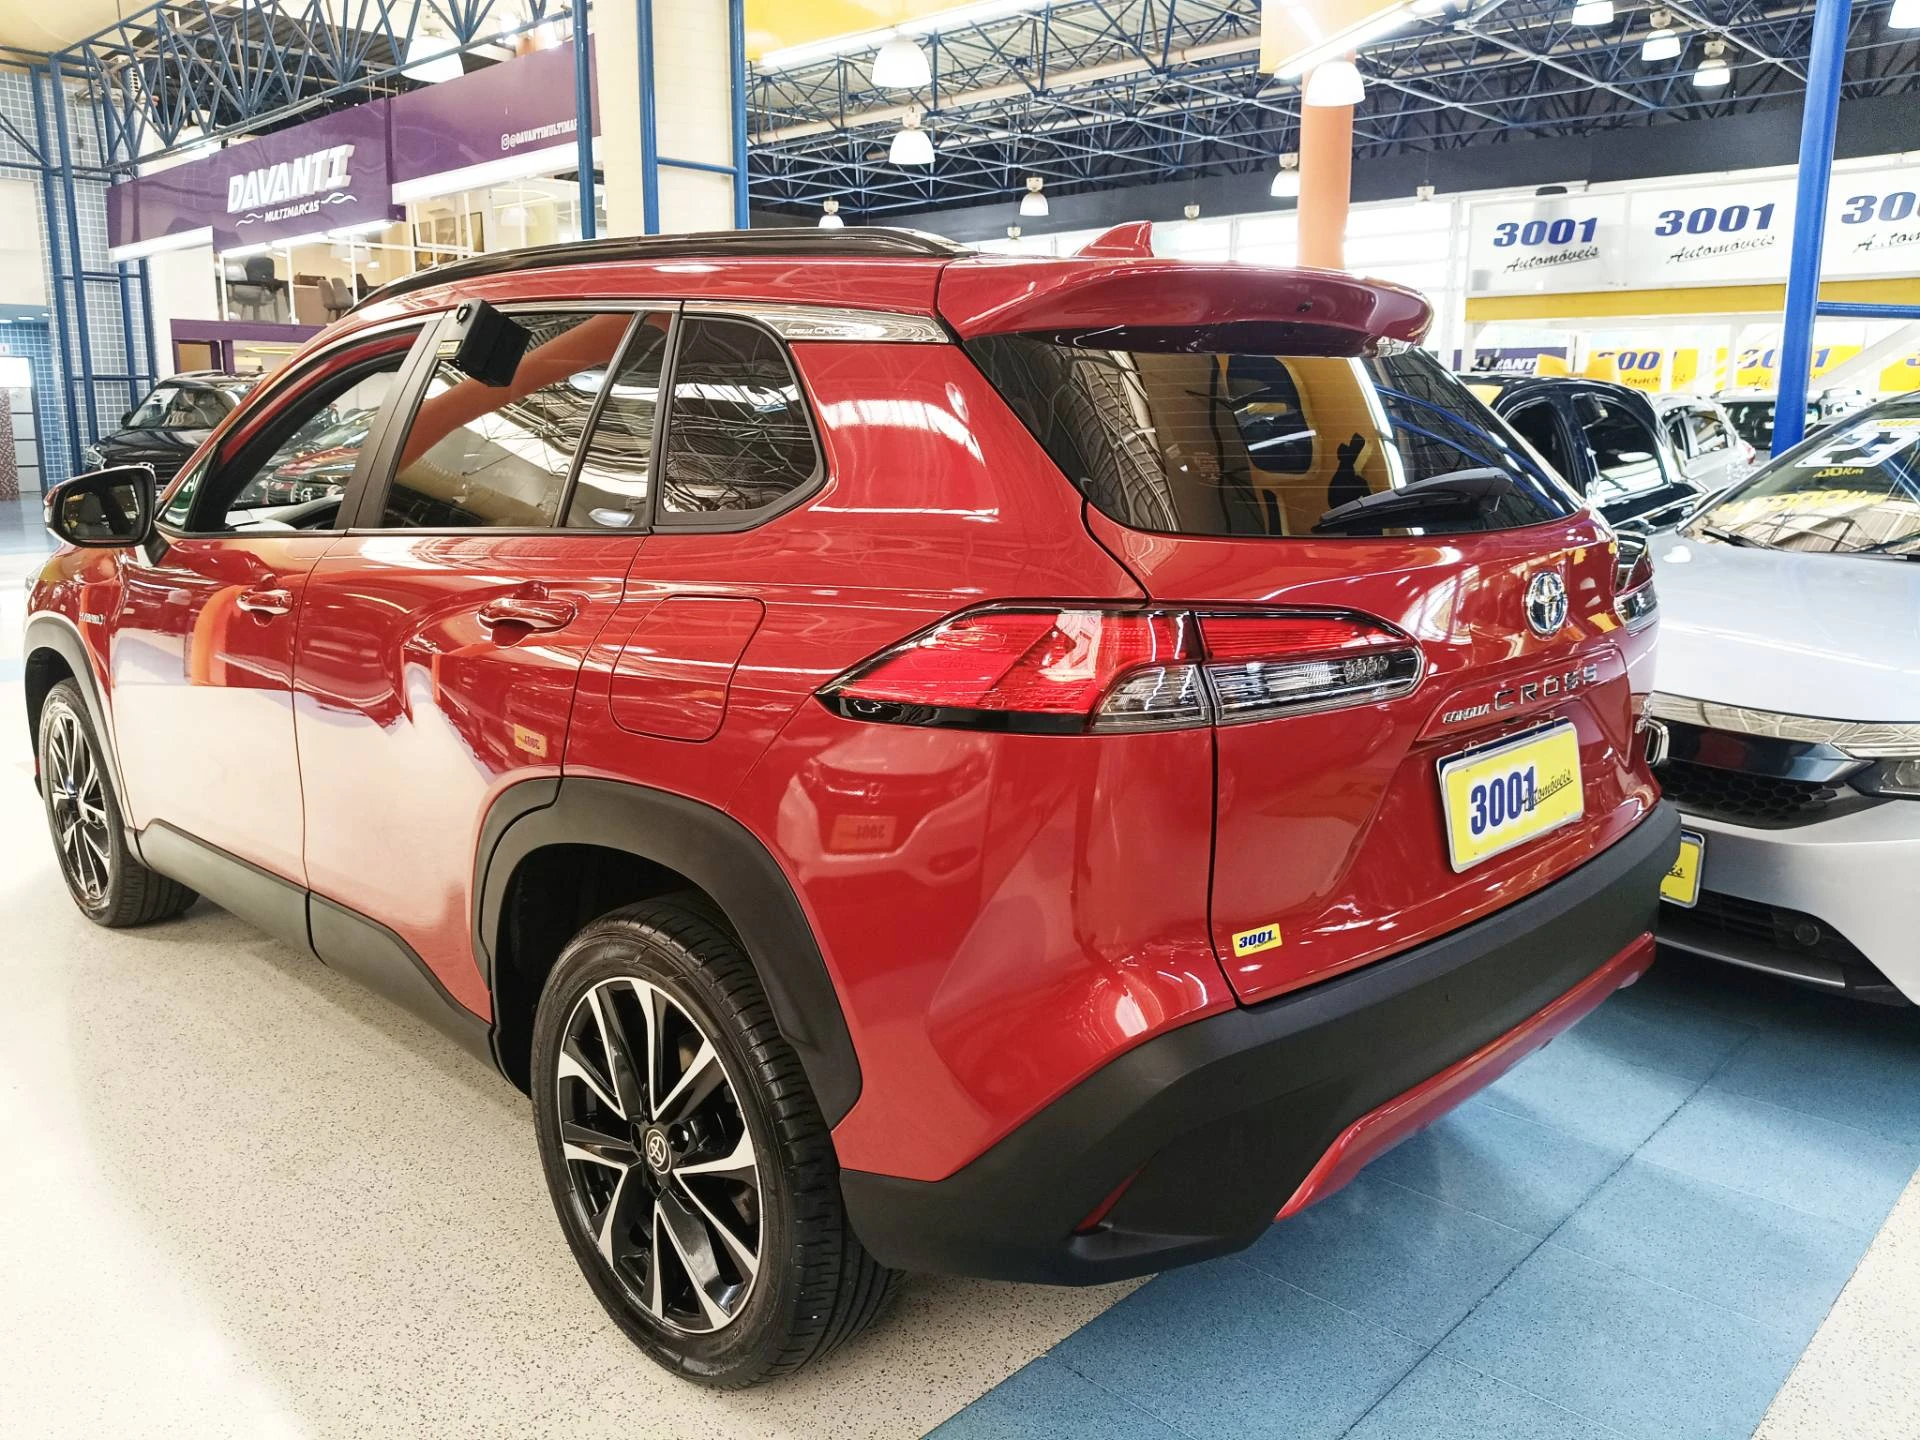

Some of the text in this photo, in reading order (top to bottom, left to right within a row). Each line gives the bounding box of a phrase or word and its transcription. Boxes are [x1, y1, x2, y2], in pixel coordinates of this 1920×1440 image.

[227, 144, 355, 214] DAVANTI
[264, 200, 319, 222] MULTIMARCAS
[1654, 203, 1775, 236] 3001
[1841, 191, 1920, 225] 30
[1493, 217, 1598, 247] 3001
[1503, 245, 1600, 273] Automóveis
[1442, 663, 1597, 723] COROLLA CROSS
[1471, 766, 1534, 835] 3001
[1239, 930, 1272, 948] 3001
